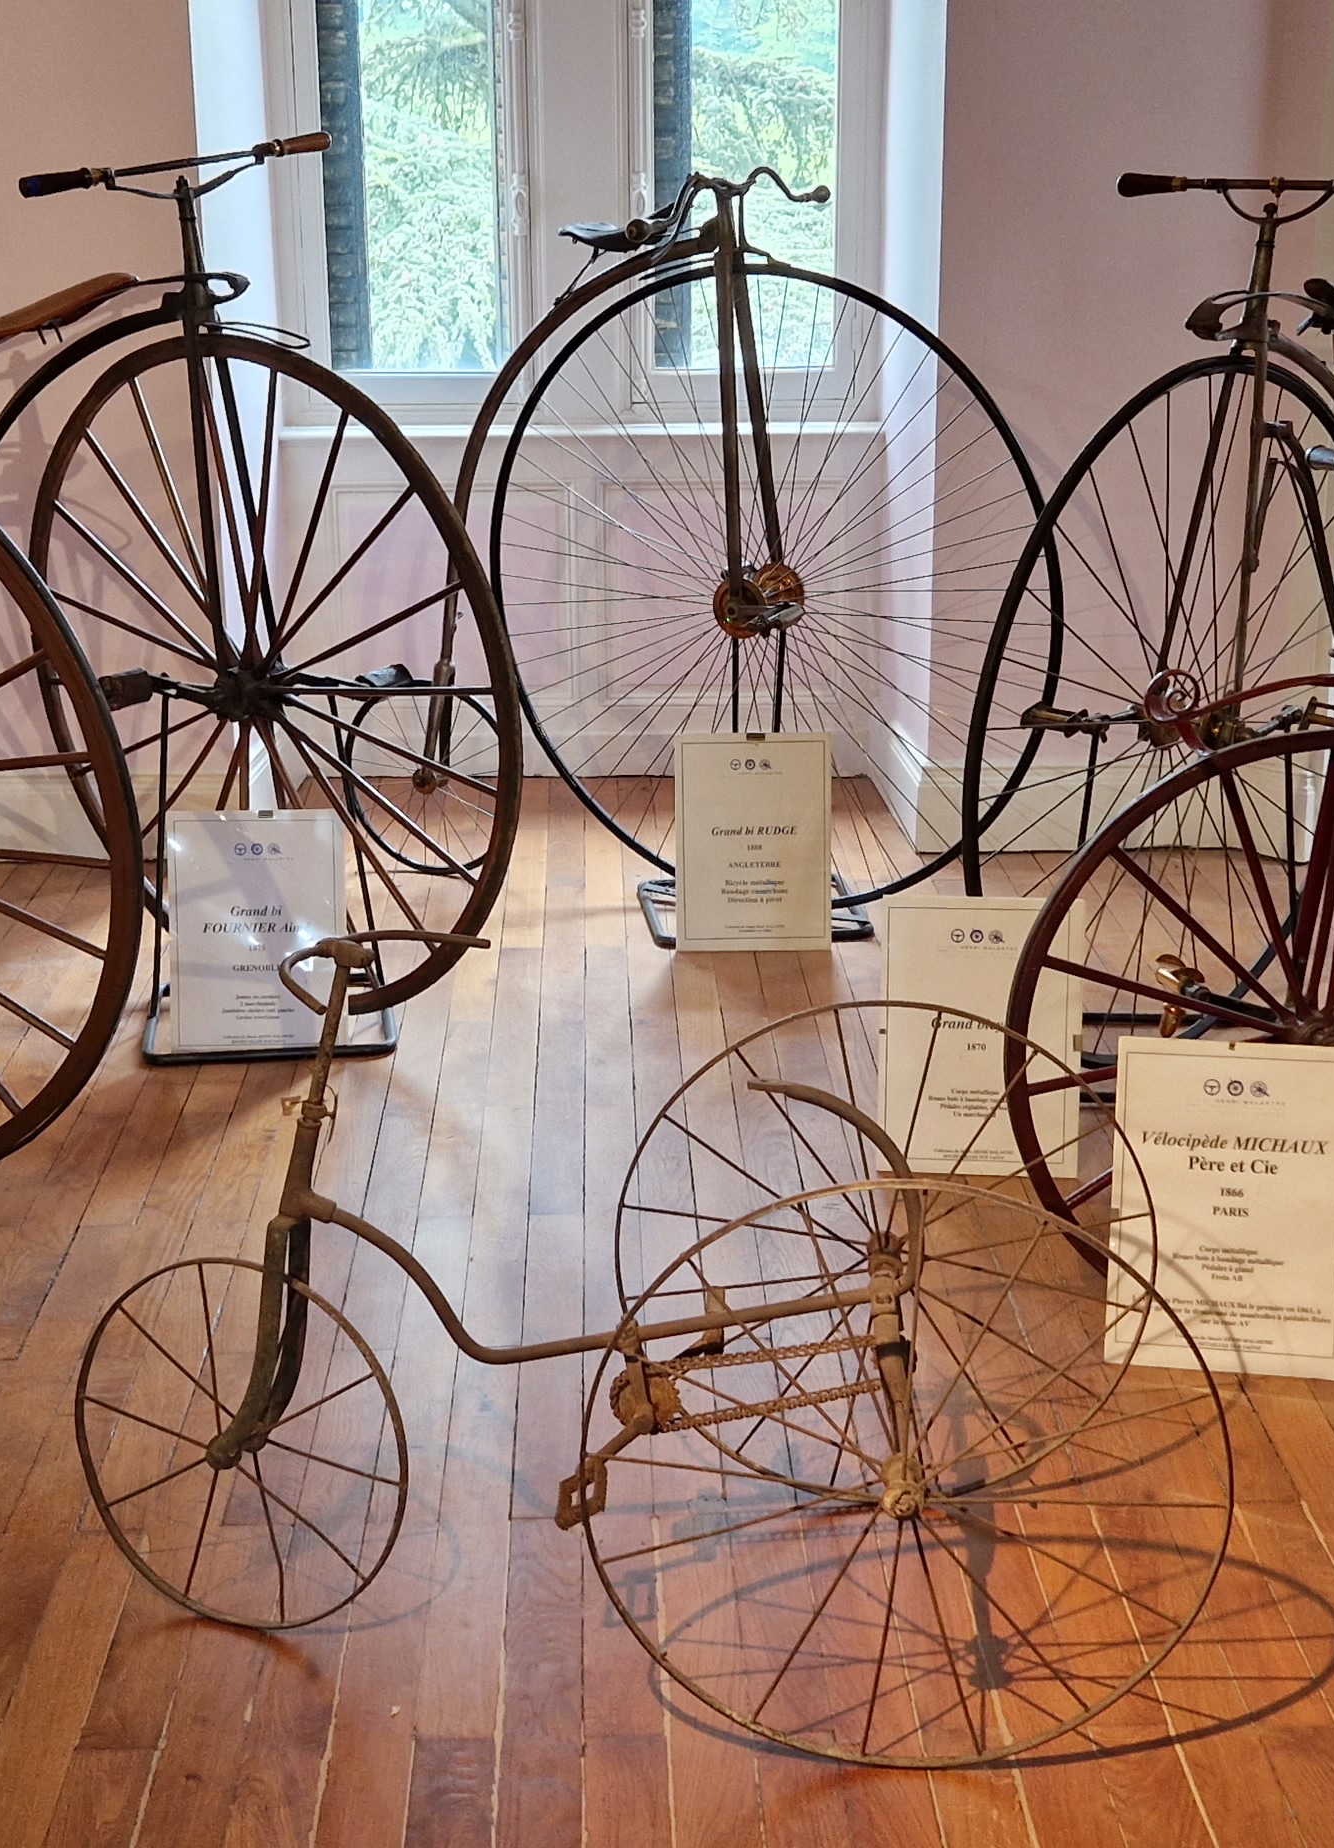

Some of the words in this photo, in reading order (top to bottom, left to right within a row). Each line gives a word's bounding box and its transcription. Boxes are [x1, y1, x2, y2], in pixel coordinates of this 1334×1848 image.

[711, 826, 743, 836] Grand
[745, 826, 754, 835] bi
[757, 825, 798, 835] RUDGE
[728, 861, 781, 869] ANGLETERRE
[230, 905, 268, 917] Grand
[271, 905, 282, 916] bi
[203, 922, 276, 933] FOURNIER
[233, 964, 280, 972] GRENOBL
[931, 1017, 973, 1029] Grand
[967, 1043, 987, 1051] 1870
[1142, 1131, 1228, 1150] Vélocipède
[1233, 1136, 1328, 1155] MICHAUX
[1188, 1156, 1225, 1172] Père
[1230, 1159, 1245, 1173] et
[1251, 1159, 1278, 1175] Cie
[1220, 1187, 1244, 1198] 1866
[1212, 1206, 1249, 1218] PARIS
